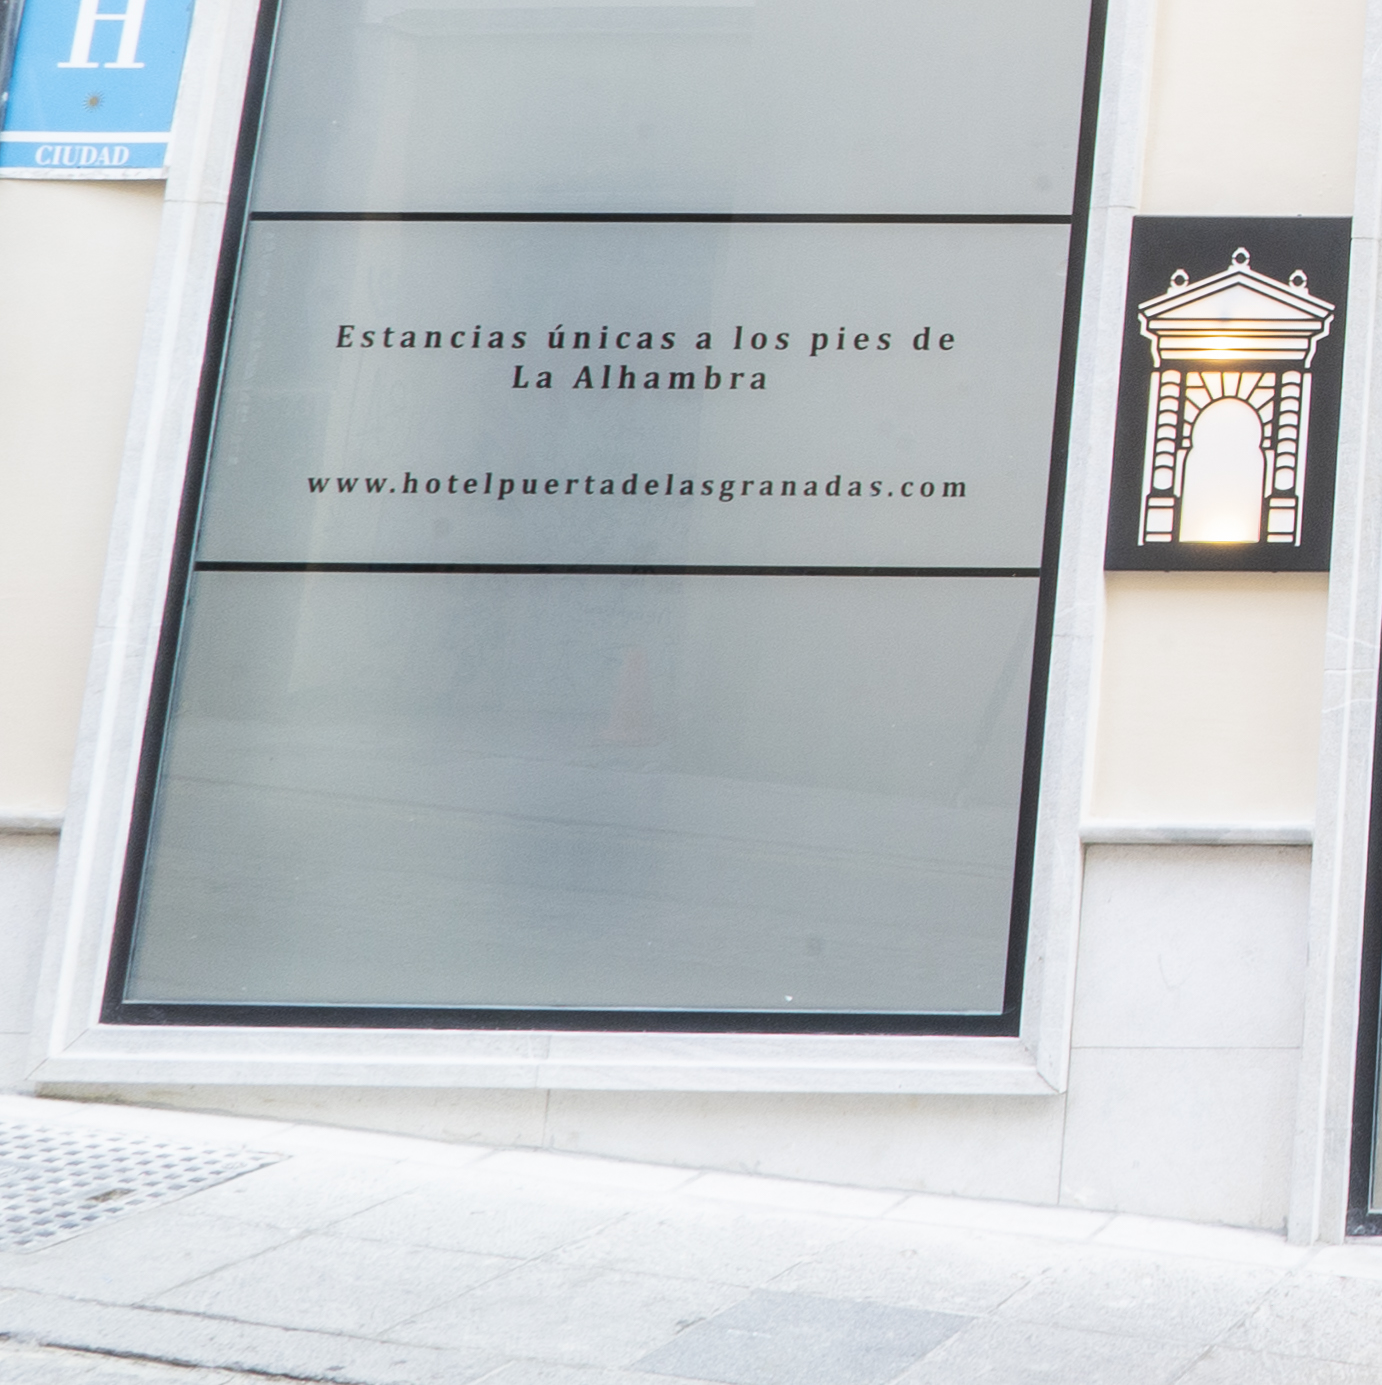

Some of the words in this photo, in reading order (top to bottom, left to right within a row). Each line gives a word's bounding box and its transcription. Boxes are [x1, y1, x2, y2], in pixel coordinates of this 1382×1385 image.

[34, 145, 130, 165] CIUDAD
[337, 325, 526, 348] Estancias
[549, 324, 675, 349] únicas
[696, 333, 711, 349] a
[734, 326, 789, 350] los
[810, 327, 890, 356] pies
[913, 327, 954, 350] de
[512, 365, 551, 388] La
[573, 365, 765, 389] Alhambra
[308, 472, 965, 502] www.hotelpuertadelasgranadas.com
